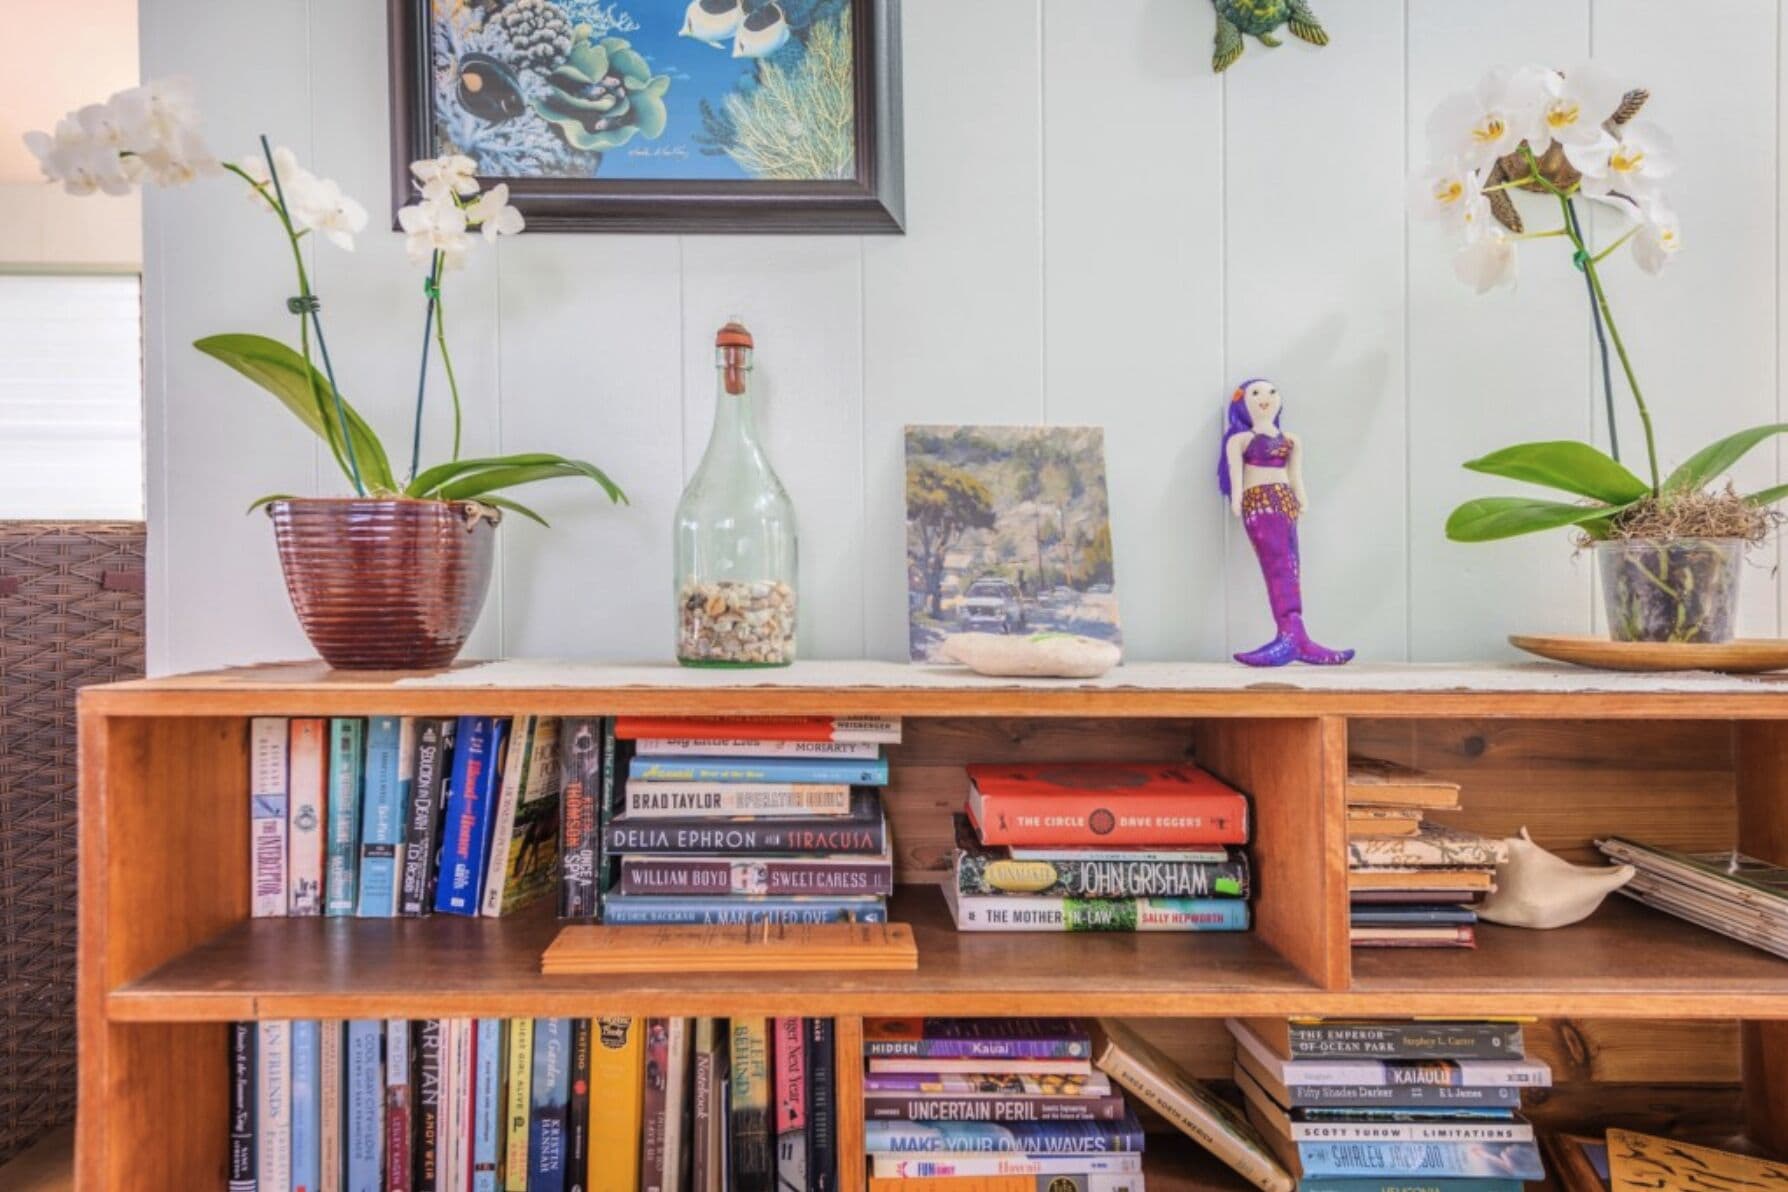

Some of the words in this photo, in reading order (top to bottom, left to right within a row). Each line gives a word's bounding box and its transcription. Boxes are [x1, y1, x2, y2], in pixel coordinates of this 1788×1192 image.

[796, 742, 857, 753] MORIARTY
[417, 746, 438, 789] SEDUCTION
[412, 798, 433, 831] DEATH
[564, 782, 582, 848] THOMSON
[632, 793, 669, 809] BRAD
[671, 793, 722, 809] TAYLOR
[1016, 815, 1041, 828] THE
[1044, 815, 1086, 828] CIRCLE
[1119, 816, 1153, 828] DAVE
[1155, 816, 1203, 828] EGGERS
[613, 830, 669, 847] DELIA
[678, 830, 757, 848] EPHRON
[787, 831, 874, 849] SIRACUSA
[257, 835, 283, 897] INTERCEPTOR
[563, 854, 580, 882] SPY
[580, 849, 594, 877] ONCE
[631, 869, 688, 886] WILLIAM
[692, 870, 729, 887] BOYD
[772, 871, 814, 889] SWEET
[816, 871, 868, 889] CARESS
[1077, 861, 1125, 894] JOHN
[1127, 861, 1209, 896] GRISHAM
[703, 911, 713, 924] A
[717, 911, 747, 926] MAN
[751, 910, 798, 924] CLLED
[986, 909, 1008, 923] THE
[1141, 912, 1168, 924] SALLY
[1171, 912, 1225, 925] HEPWORTH
[783, 1018, 800, 1042] nger
[1299, 1030, 1322, 1041] THE
[1327, 1029, 1385, 1041] EMPEROR
[365, 1033, 377, 1065] COOL
[750, 1038, 765, 1080] LEFT
[787, 1045, 802, 1073] Next
[872, 1043, 919, 1055] HIDDEN
[972, 1041, 1010, 1055] Kauai
[1299, 1041, 1316, 1051] OF
[1319, 1041, 1361, 1052] OCEAN
[1364, 1042, 1396, 1052] PARK
[421, 1020, 440, 1105] ARTIAN
[546, 1039, 562, 1088] Garden
[733, 1025, 750, 1097] BEHIND
[267, 1051, 283, 1119] FRIENDS
[695, 1054, 710, 1119] Notebook
[787, 1074, 802, 1105] Year
[1296, 1087, 1321, 1100] Fifty
[1324, 1088, 1358, 1099] Shades
[1359, 1087, 1394, 1098] Darker
[1455, 1088, 1482, 1099] James
[908, 1101, 991, 1121] UNCERTAIN
[995, 1101, 1038, 1121] PERIL
[1120, 1071, 1144, 1092] BIRDS
[1144, 1088, 1157, 1101] OF
[1157, 1096, 1182, 1118] NORTH
[1182, 1114, 1215, 1145] AMERICA
[425, 1112, 436, 1146] ANDY
[1303, 1128, 1347, 1137] SCOTT
[1354, 1128, 1401, 1137] TUROW
[1422, 1129, 1513, 1138] LIMITATIONS
[539, 1118, 550, 1172] HANNAH
[549, 1118, 561, 1170] KRISTIN
[889, 1136, 938, 1152] MAKE
[943, 1136, 993, 1152] YOUR
[997, 1136, 1040, 1152] OWN
[1044, 1135, 1107, 1153] WAVES
[424, 1149, 435, 1180] WEIR
